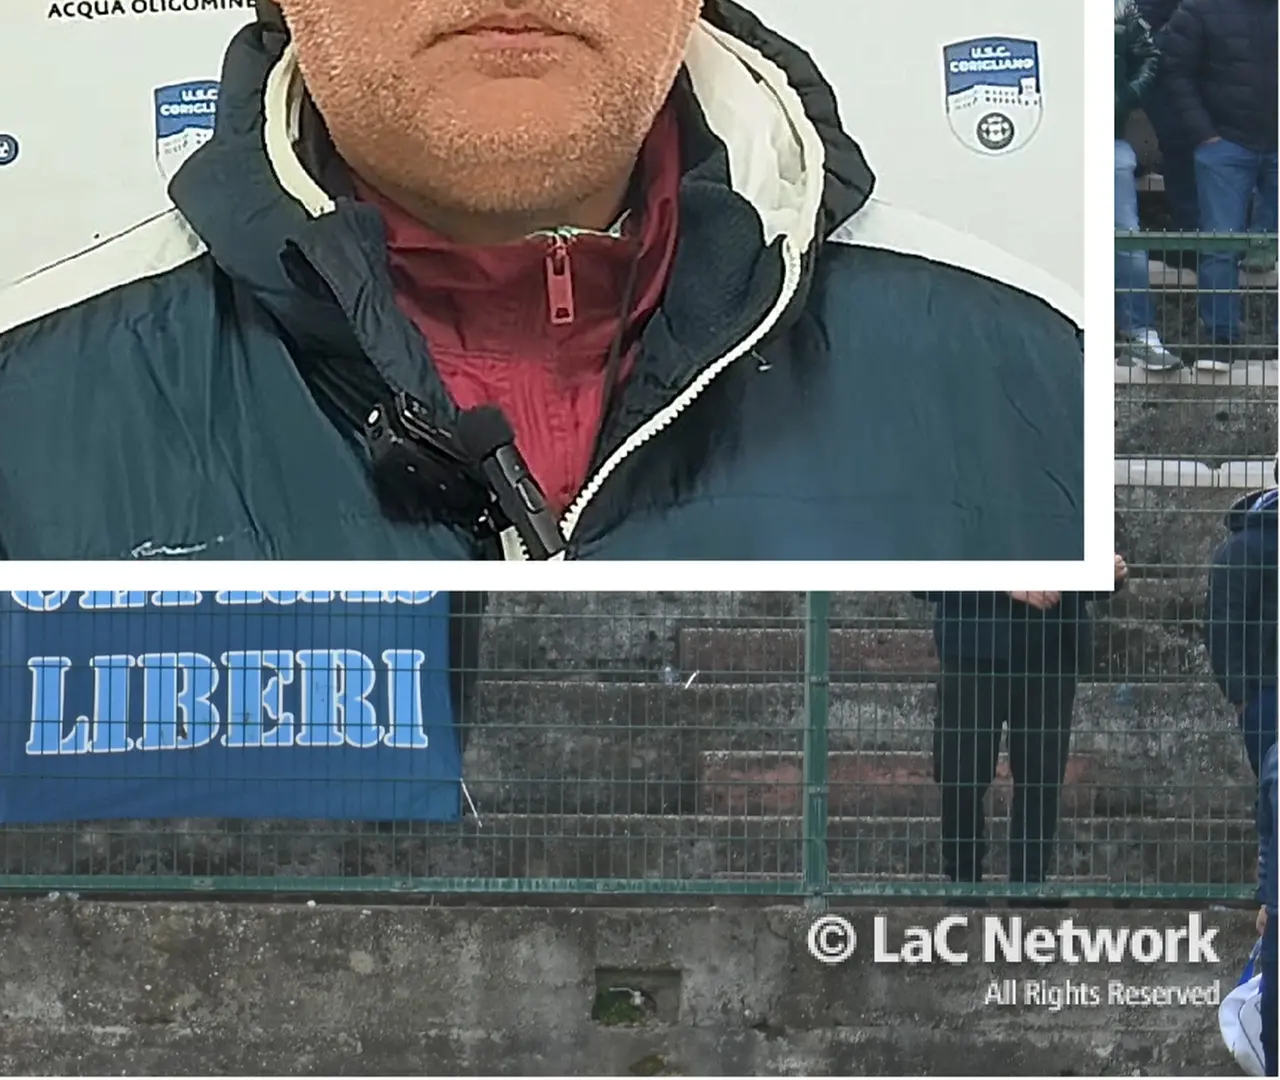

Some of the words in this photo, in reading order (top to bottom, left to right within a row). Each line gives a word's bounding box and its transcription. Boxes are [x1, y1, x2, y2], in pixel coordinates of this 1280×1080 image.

[47, 0, 126, 19] ACQUA
[949, 58, 1035, 73] CORIGLIANO
[24, 647, 429, 756] LIBERI
